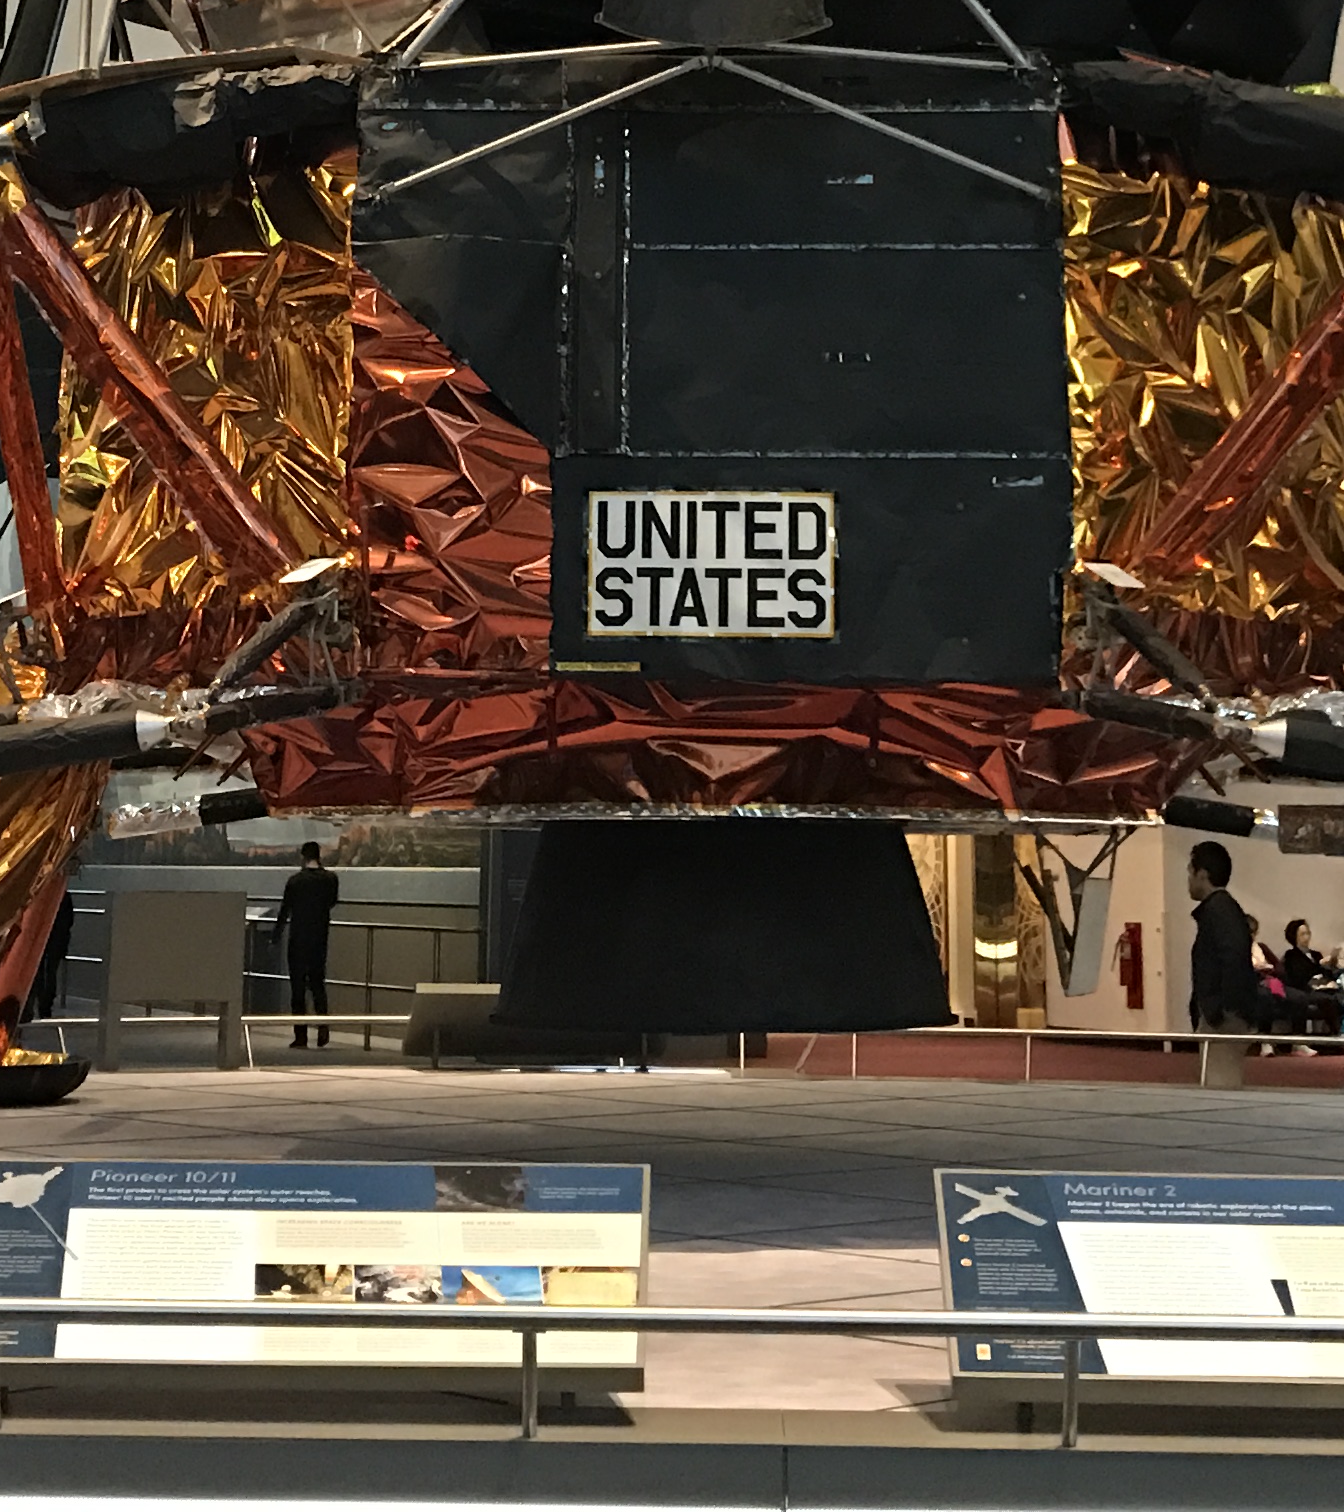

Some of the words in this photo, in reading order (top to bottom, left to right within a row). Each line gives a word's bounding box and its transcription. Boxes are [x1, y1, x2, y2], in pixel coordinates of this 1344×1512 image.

[597, 500, 826, 560] UNITED
[595, 567, 827, 628] STATES
[90, 1169, 178, 1183] Pioneer
[185, 1170, 236, 1184] 10/11
[1064, 1183, 1156, 1197] Mariner
[1164, 1185, 1177, 1197] 2
